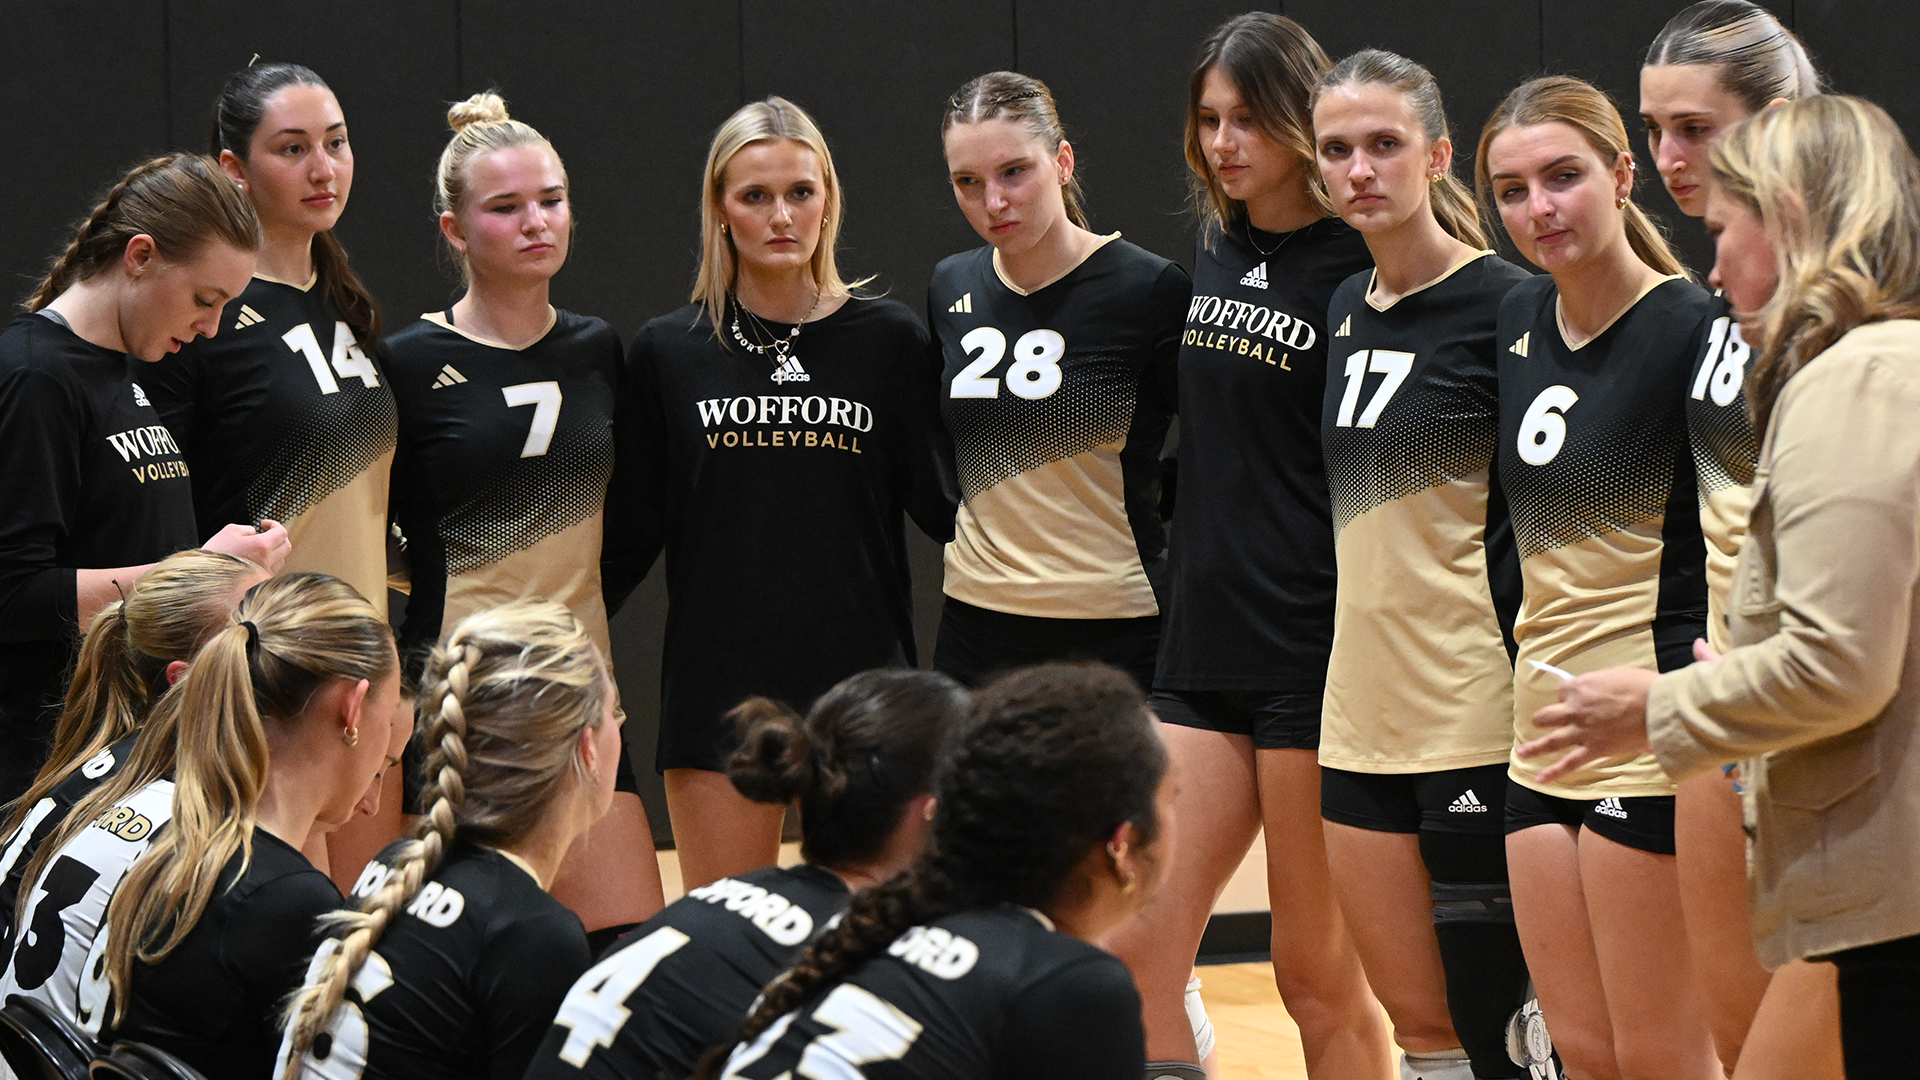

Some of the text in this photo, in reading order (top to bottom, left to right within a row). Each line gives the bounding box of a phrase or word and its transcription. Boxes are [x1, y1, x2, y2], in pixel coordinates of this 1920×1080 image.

[1240, 276, 1269, 290] adidas
[1181, 329, 1292, 372] VOLLEYBALL
[1186, 295, 1317, 351] WOFFORD
[281, 321, 381, 395] 14
[950, 326, 1066, 400] 28
[1691, 316, 1751, 407] 18
[696, 395, 874, 433] WOFFORD
[1336, 349, 1416, 429] 17
[106, 425, 181, 463] WOFFO
[501, 381, 563, 459] 7
[706, 430, 862, 454] VOLLEYBALL
[1517, 384, 1580, 467] 6
[1448, 803, 1489, 813] adidas
[1594, 804, 1628, 819] adidas
[553, 925, 691, 1069] 4
